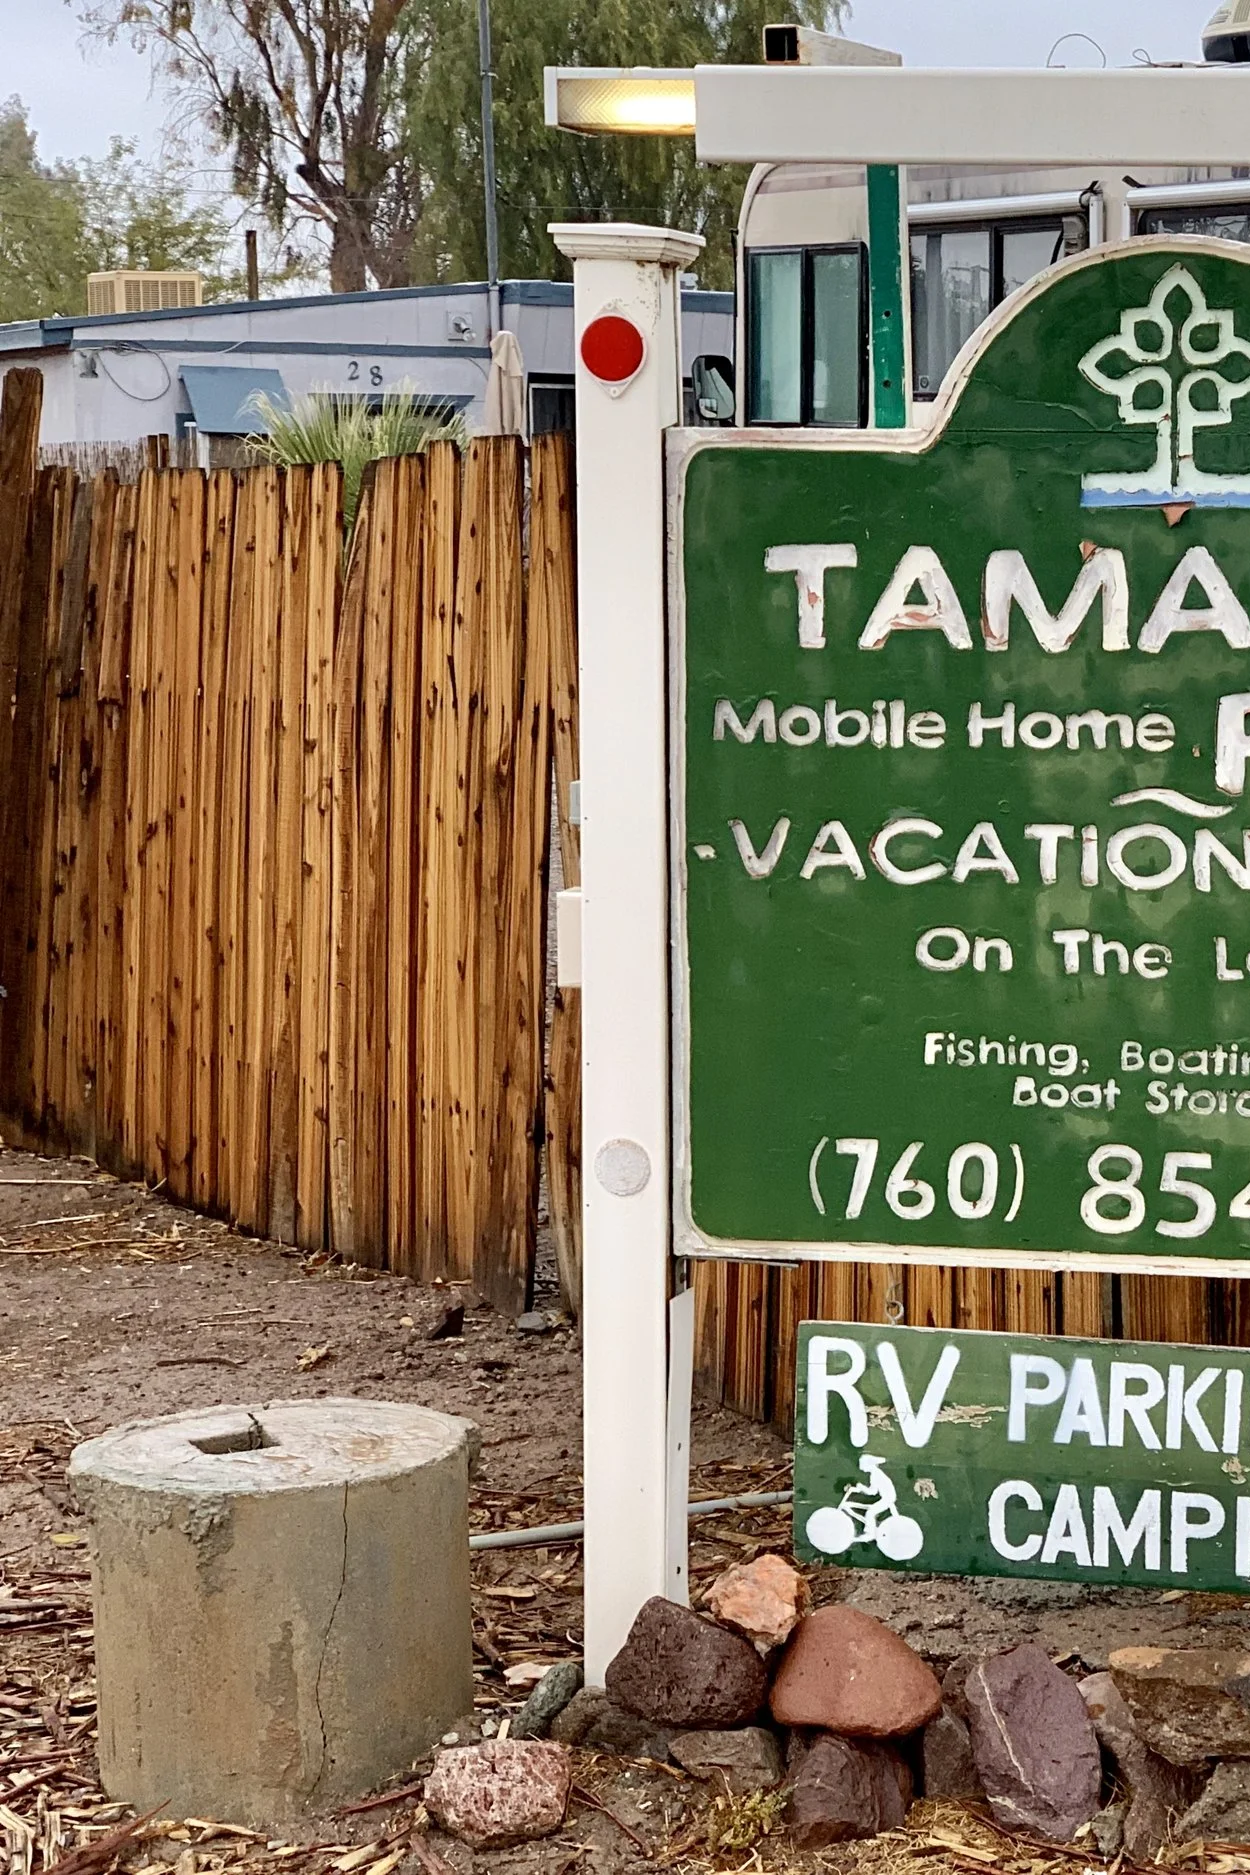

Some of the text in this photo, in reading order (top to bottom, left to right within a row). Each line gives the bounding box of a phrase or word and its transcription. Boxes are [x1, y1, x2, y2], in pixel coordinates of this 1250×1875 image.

[712, 698, 947, 748] Mobile
[967, 700, 1176, 752] Home
[915, 926, 1014, 974] On
[1052, 928, 1173, 981] The
[924, 1031, 1091, 1076] Fishing,
[1012, 1076, 1121, 1111] Boat
[808, 1134, 1025, 1225] (760)
[806, 1335, 961, 1449] RV
